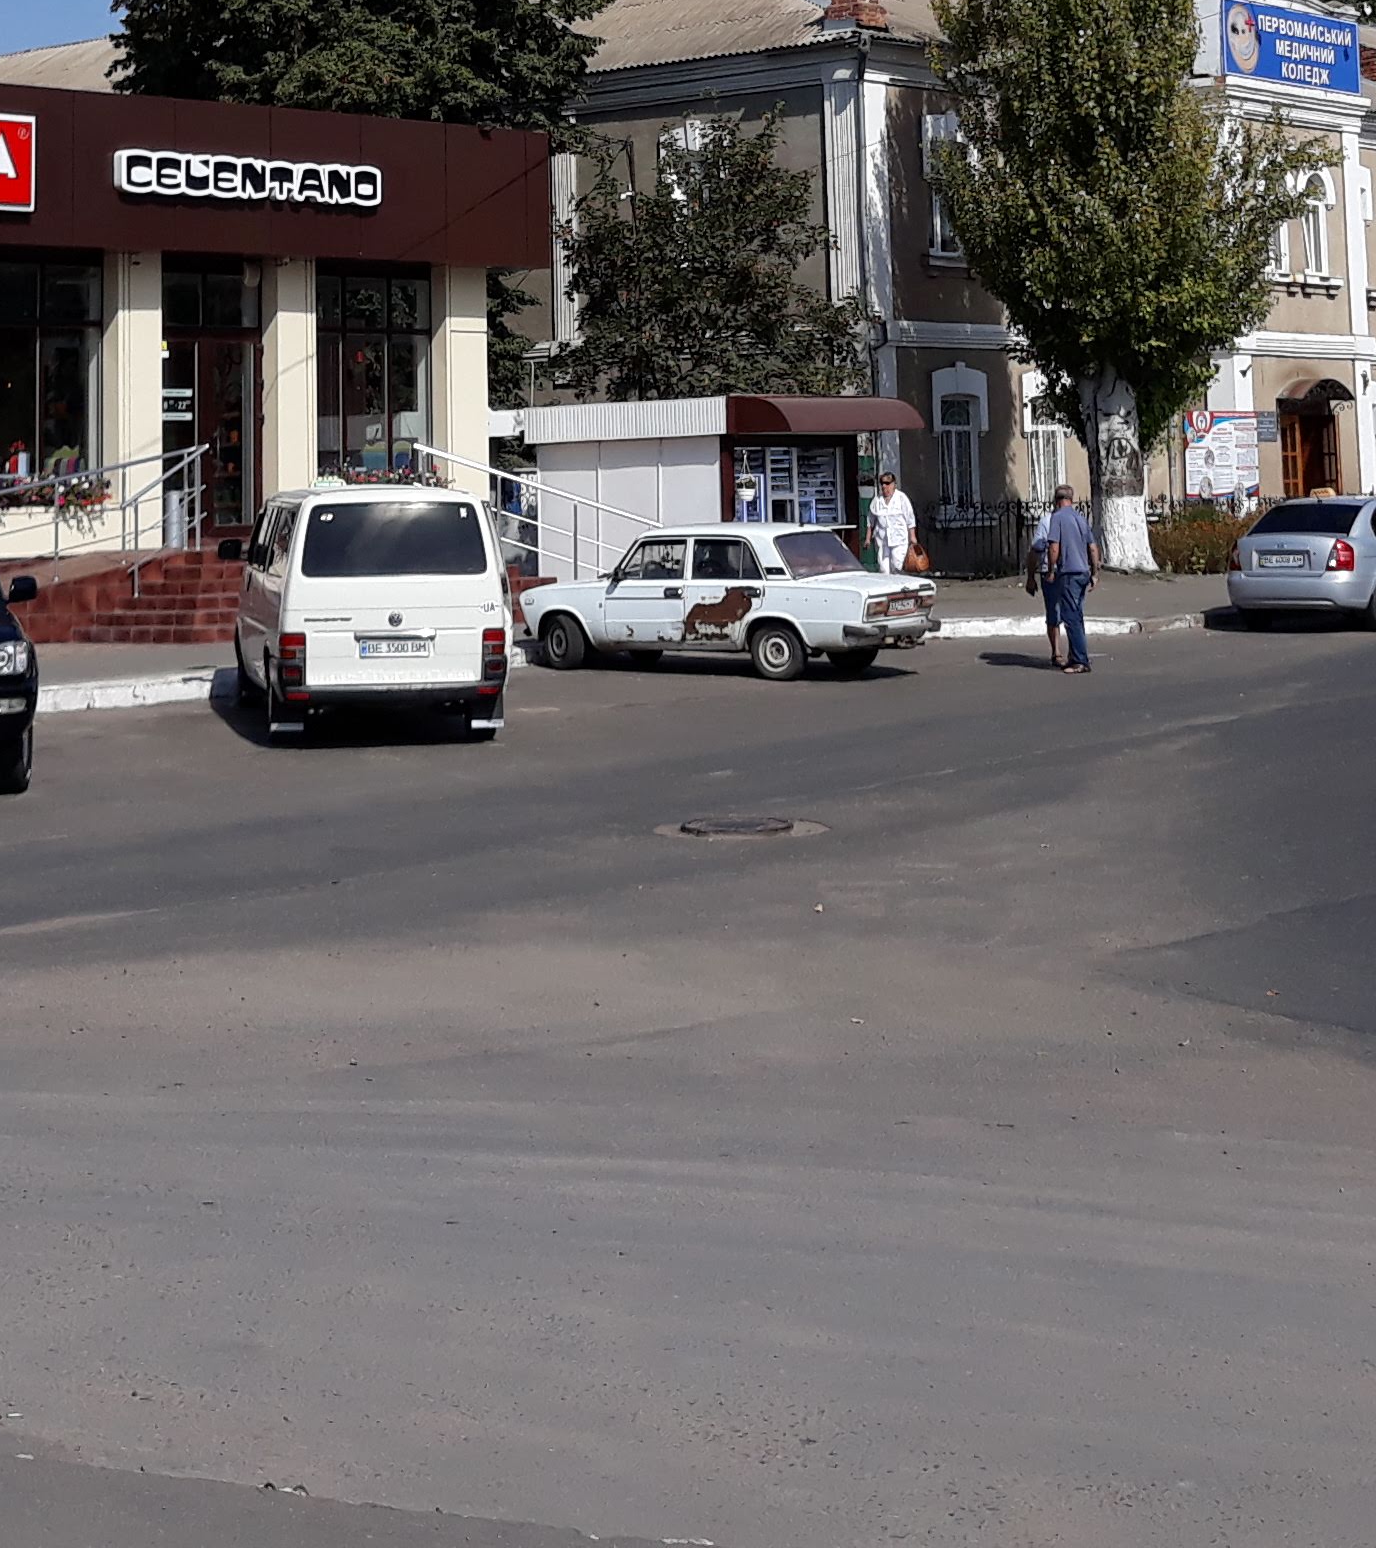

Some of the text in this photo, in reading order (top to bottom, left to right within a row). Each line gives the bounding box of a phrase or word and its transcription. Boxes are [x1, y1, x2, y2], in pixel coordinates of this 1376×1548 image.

[1257, 14, 1352, 47] ПЕРВОМАЙСЬКИЙ
[1275, 39, 1335, 65] МЕДИЧНИЙ
[1281, 62, 1331, 85] КОЛЕДЖ
[117, 150, 381, 205] CELENTANO
[483, 603, 496, 613] UA
